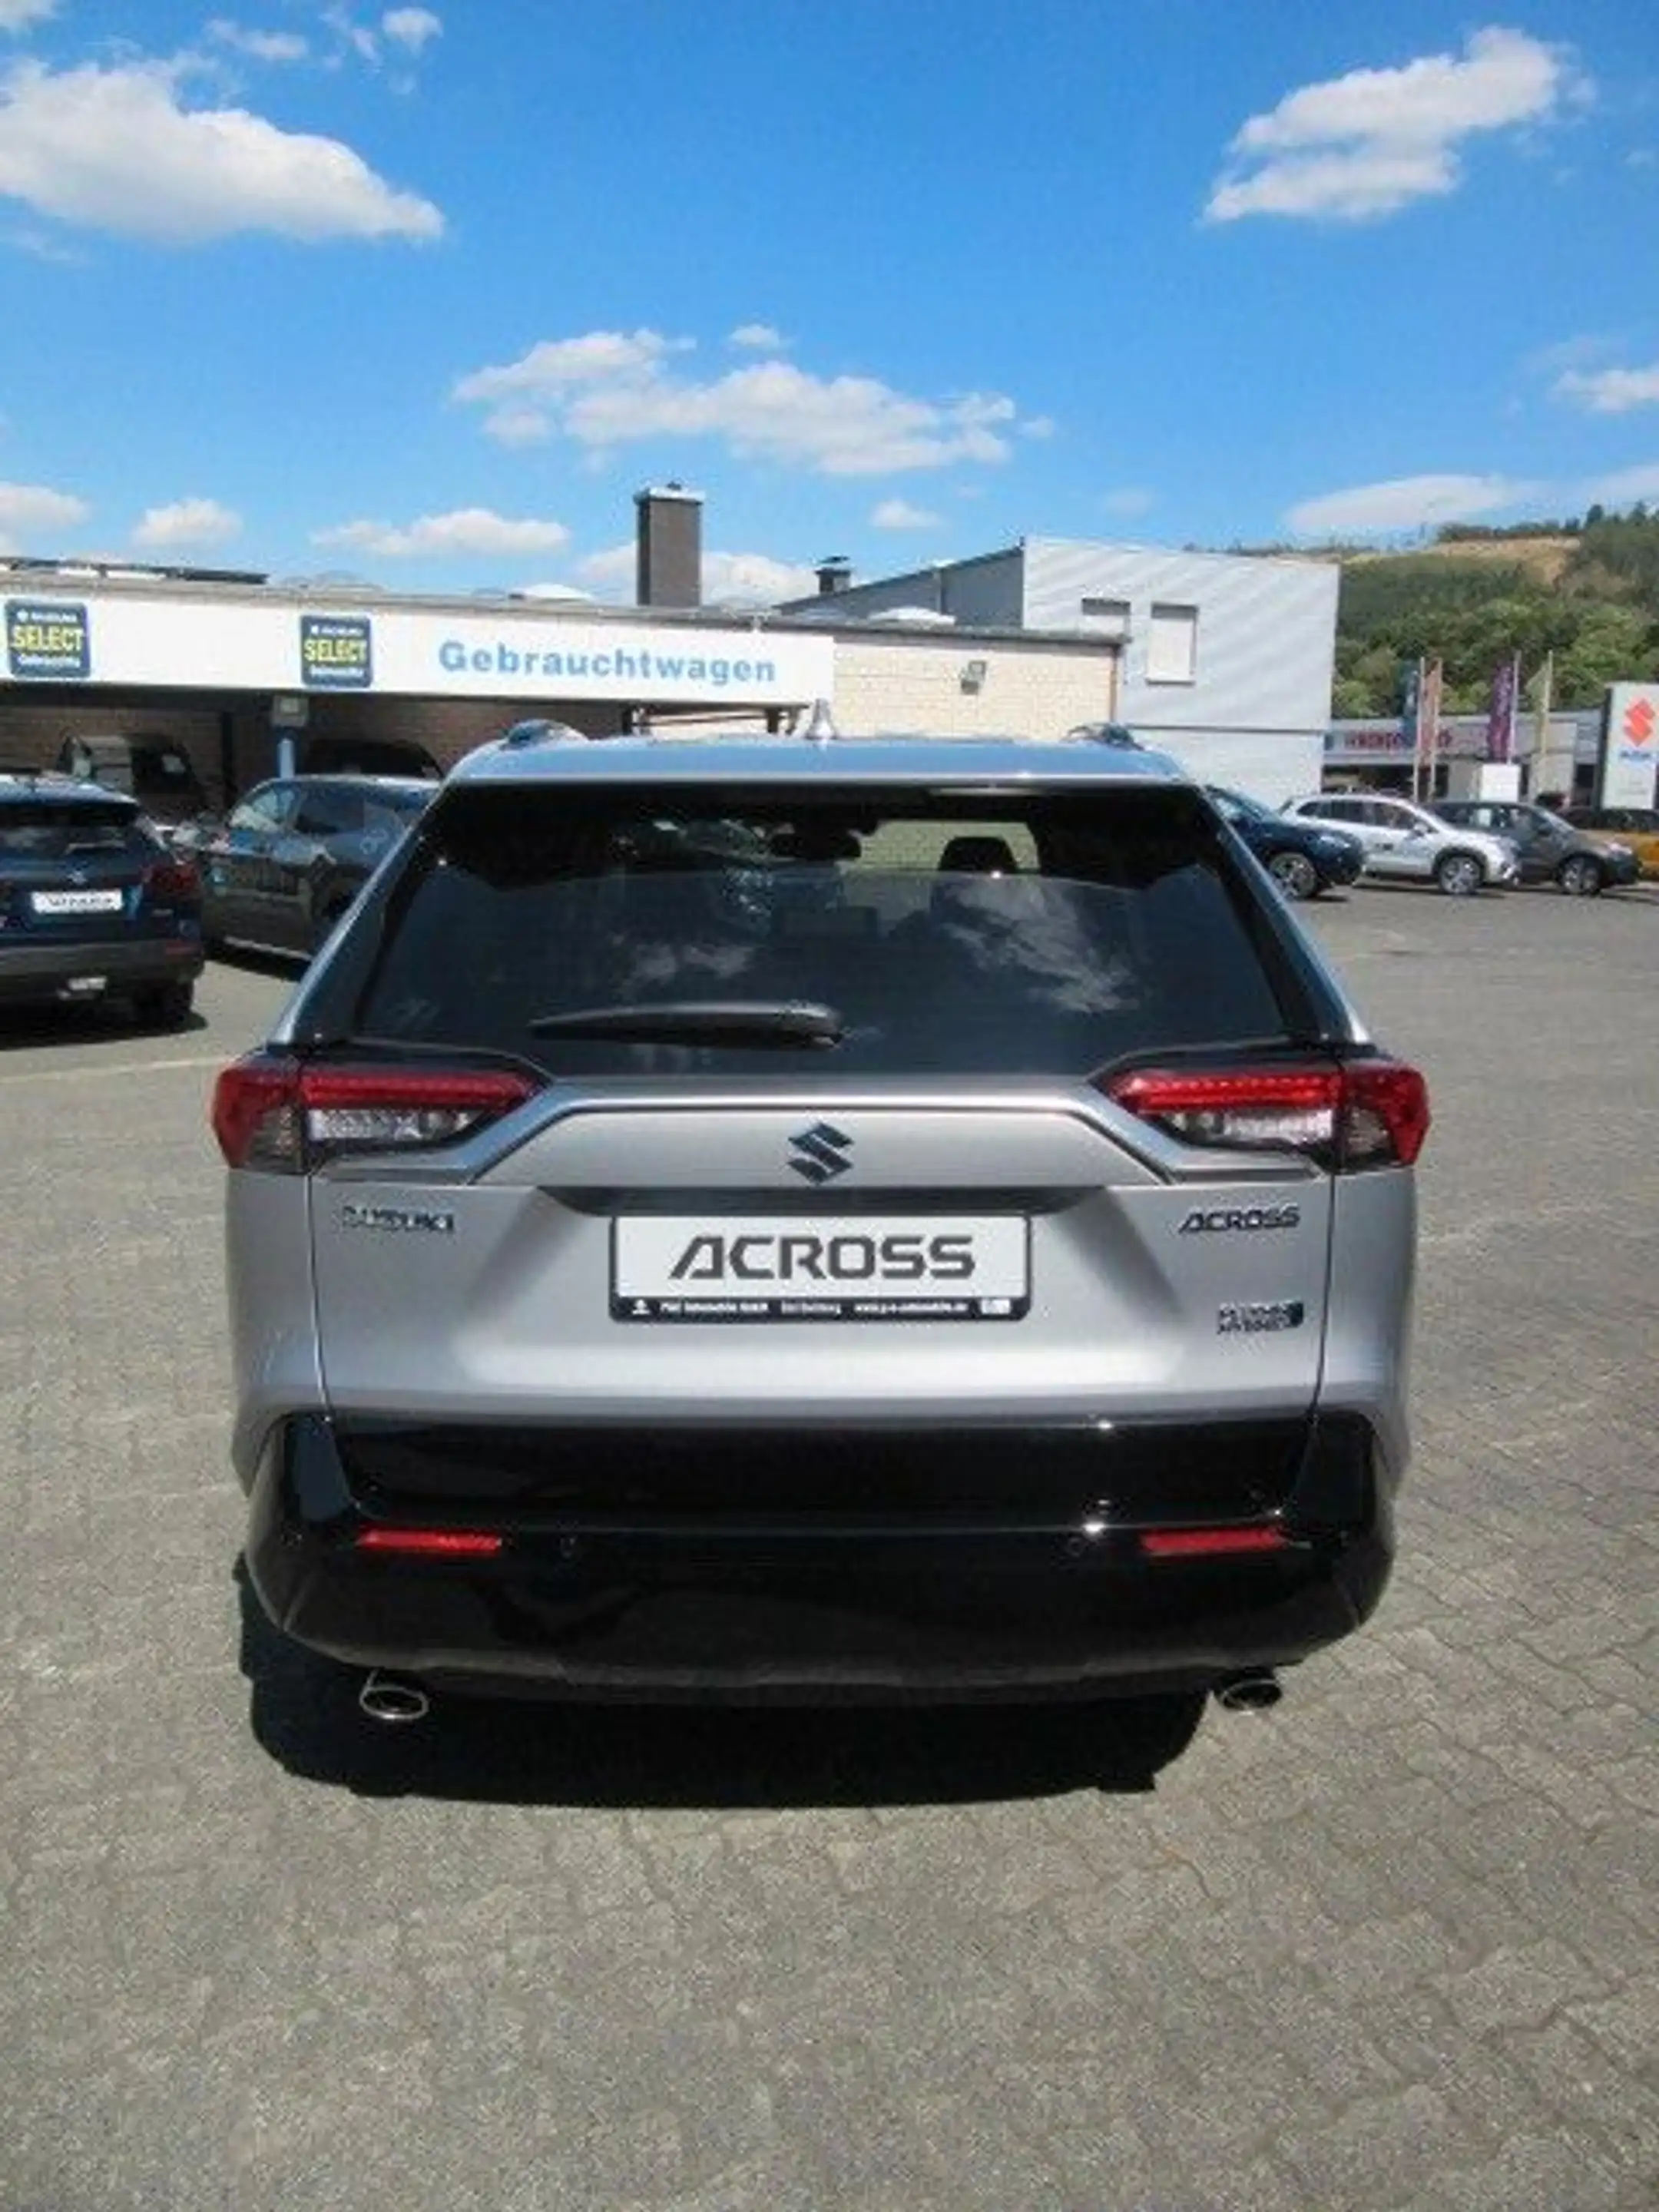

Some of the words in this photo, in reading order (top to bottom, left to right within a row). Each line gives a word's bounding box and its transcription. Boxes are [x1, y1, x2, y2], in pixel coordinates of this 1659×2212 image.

[12, 625, 84, 651] SELECT
[303, 638, 367, 663] SELECT
[439, 641, 777, 686] Gebrauchtwagen
[1177, 1203, 1301, 1234] ACROSS
[668, 1235, 975, 1280] ACROSS
